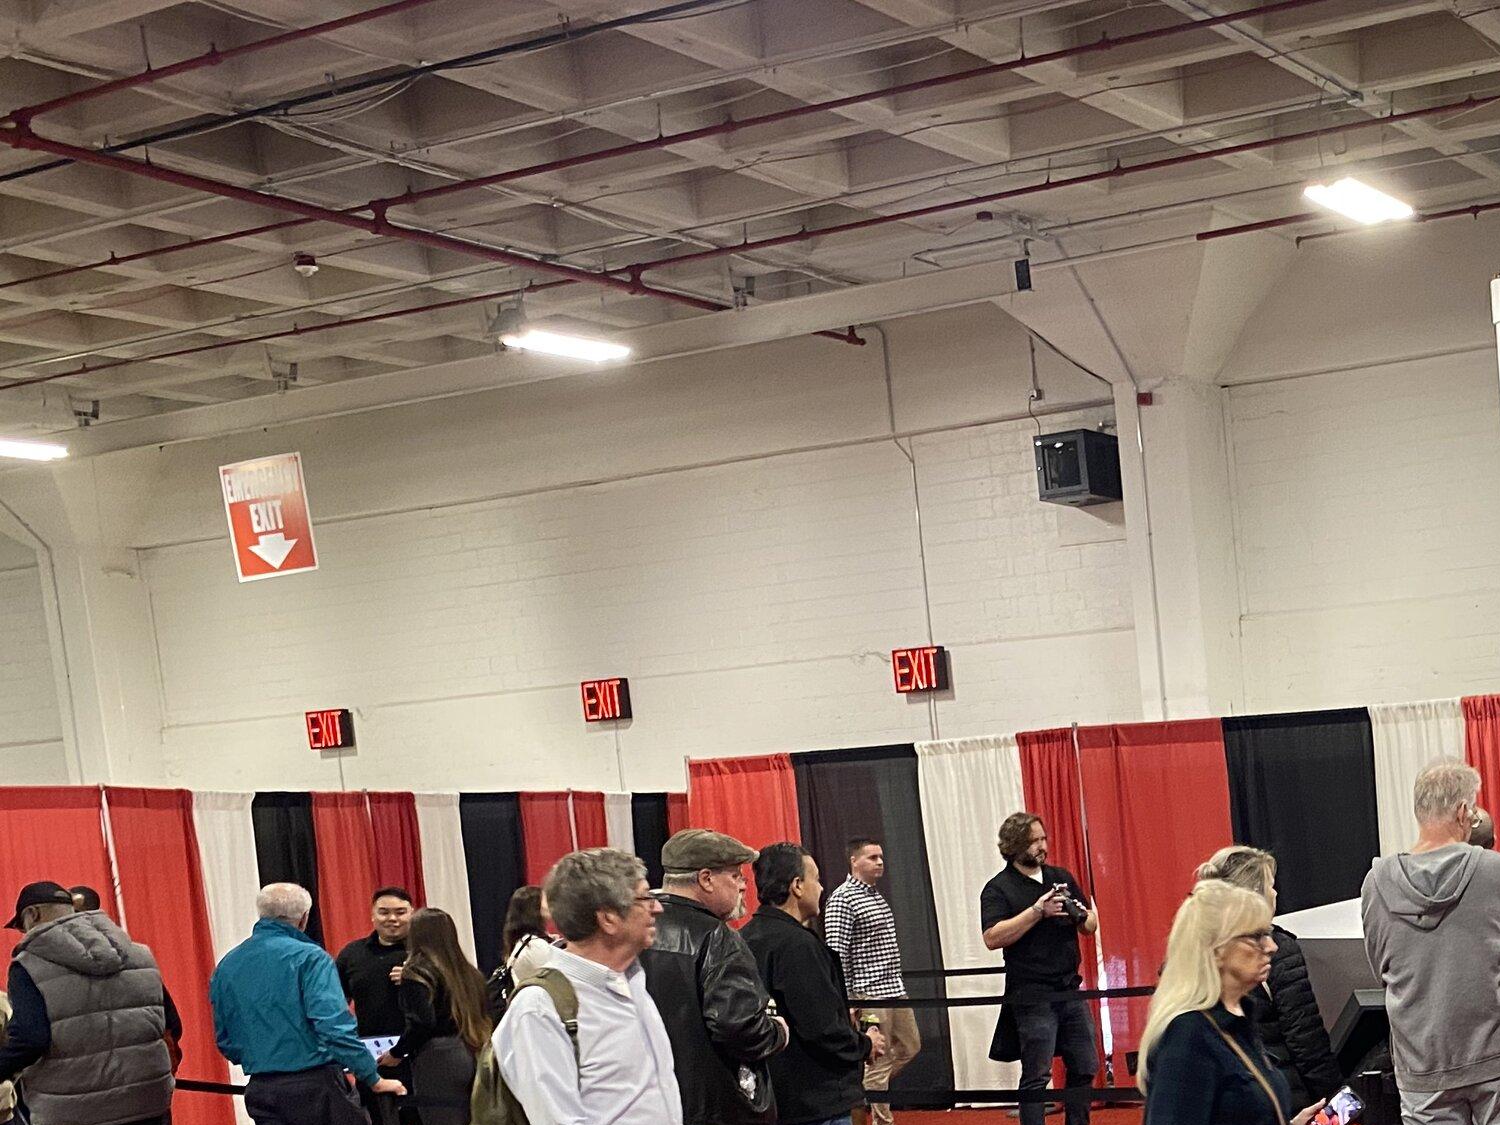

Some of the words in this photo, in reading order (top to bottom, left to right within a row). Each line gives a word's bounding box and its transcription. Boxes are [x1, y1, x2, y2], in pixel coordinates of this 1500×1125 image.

[249, 500, 284, 534] EXIT
[895, 649, 937, 690] EXIT
[583, 680, 620, 719] EXIT
[308, 711, 342, 747] EXIT
